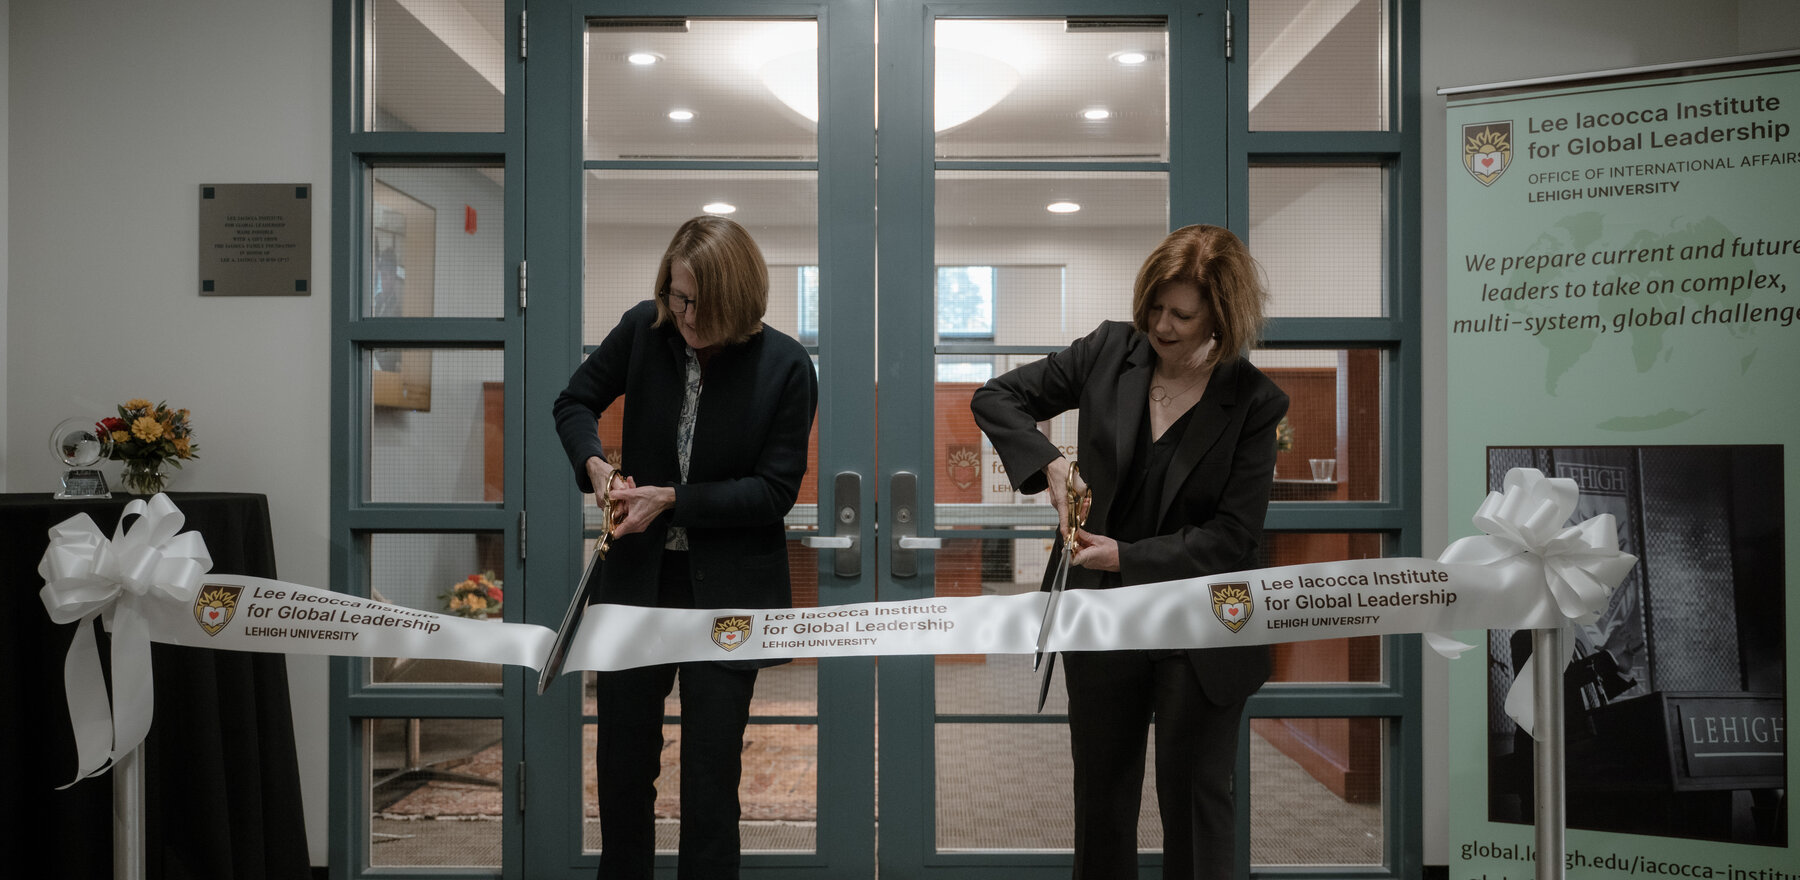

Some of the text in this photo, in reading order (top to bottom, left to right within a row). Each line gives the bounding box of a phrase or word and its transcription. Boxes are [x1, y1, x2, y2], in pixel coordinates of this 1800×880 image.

[1528, 94, 1781, 134] Lee Iacocca Institute
[1528, 120, 1790, 159] for Global Leadership
[1528, 170, 1580, 185] OFFICE
[1585, 168, 1605, 180] OF
[1610, 157, 1735, 178] INTERNATIONAL
[1528, 181, 1680, 203] LEHIGH UNIVERSITY
[1465, 237, 1800, 275] We prepare current and future
[1481, 270, 1786, 302] leaders to take on complex,
[1453, 311, 1607, 337] multi-system,
[1613, 305, 1685, 333] global
[1261, 569, 1449, 591] Lee Iacocca Institute
[253, 587, 285, 600] Lee
[290, 592, 361, 606] Iacocca
[1264, 589, 1457, 611] for Global Leadership
[247, 604, 441, 634] for Global Leadership
[764, 604, 947, 621] Lee Iacocca Institute
[1267, 615, 1380, 630] LEHIGH UNIVERSITY
[245, 627, 359, 641] LEHIGH UNIVERSITY
[763, 619, 955, 635] for Global Leadership
[762, 638, 877, 649] LEHIGH UNIVERSITY
[1689, 717, 1784, 744] LEHIGH
